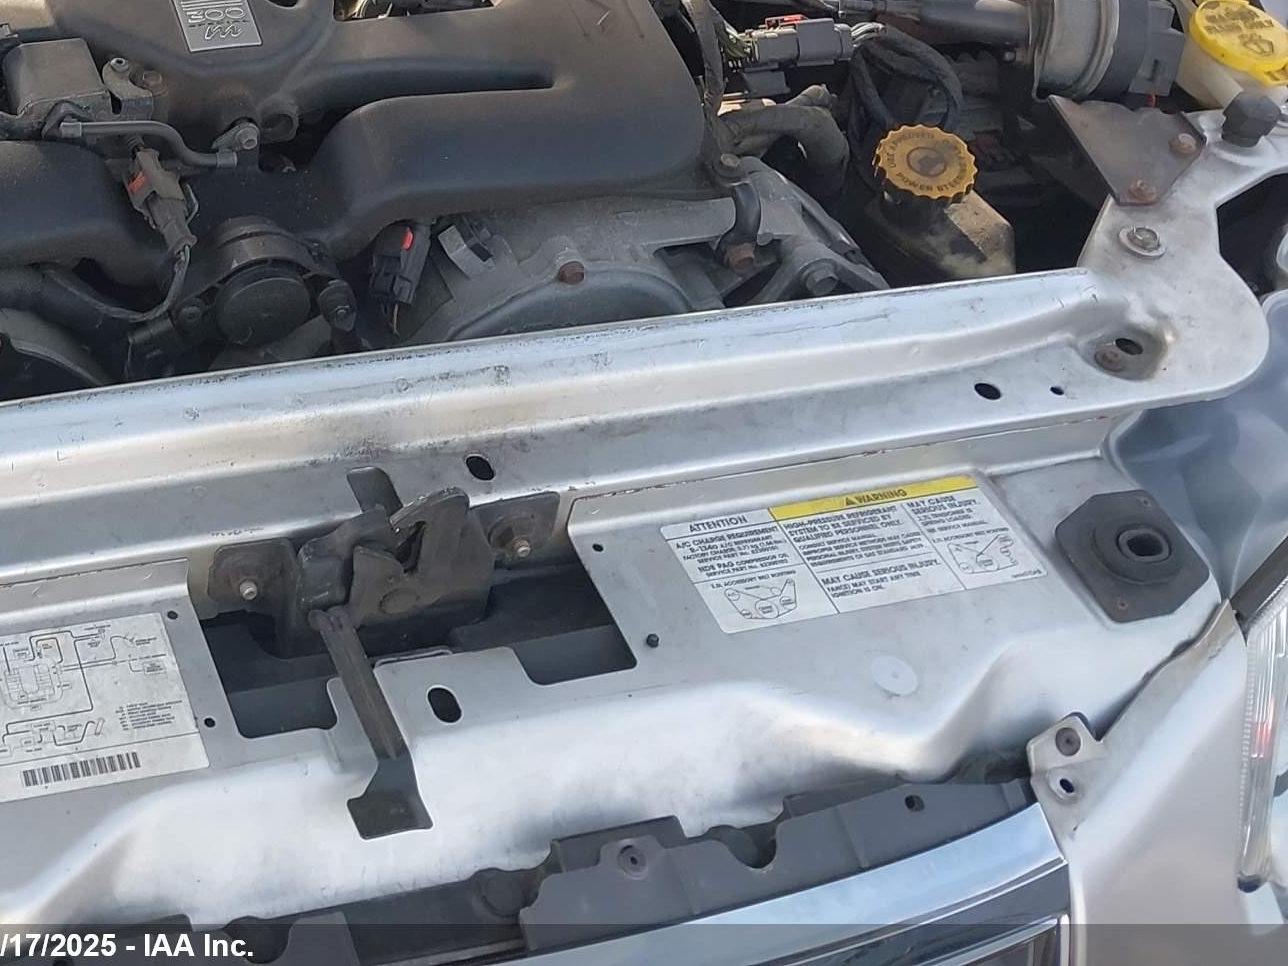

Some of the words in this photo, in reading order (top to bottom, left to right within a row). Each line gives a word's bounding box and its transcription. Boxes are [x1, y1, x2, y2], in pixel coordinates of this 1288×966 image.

[186, 7, 246, 23] 300
[856, 489, 907, 503] WARNING
[687, 516, 747, 532] ATTENTION
[821, 577, 842, 585] MAY
[841, 571, 871, 581] CAUSE
